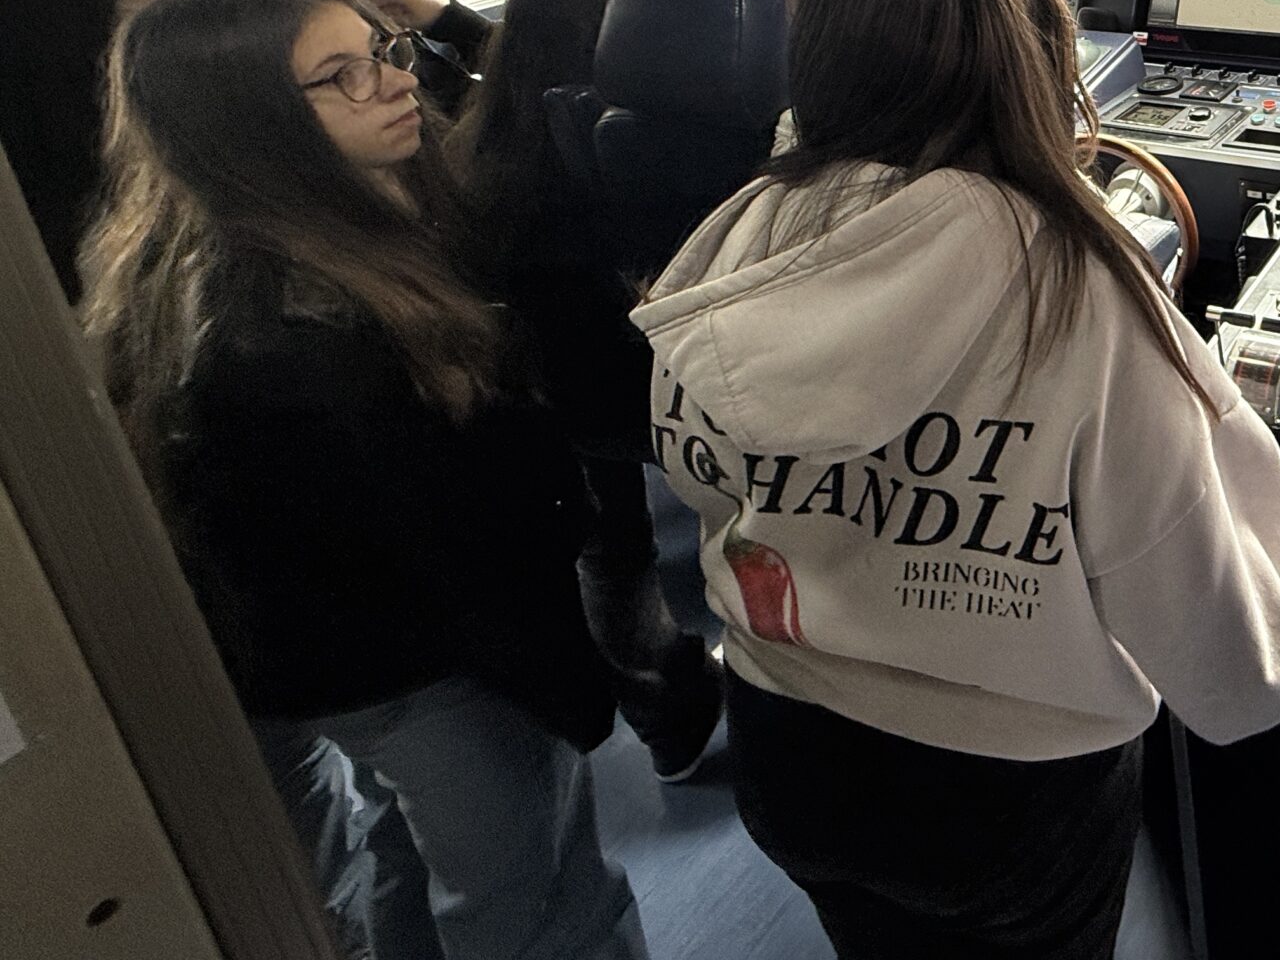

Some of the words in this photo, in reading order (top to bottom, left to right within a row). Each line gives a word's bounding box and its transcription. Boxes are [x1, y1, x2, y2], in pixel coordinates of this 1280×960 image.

[868, 411, 1035, 484] OT
[743, 451, 1070, 566] HANDLE
[894, 586, 958, 612] THE
[965, 591, 1042, 621] HEAT
[903, 560, 1040, 597] BRINGING
